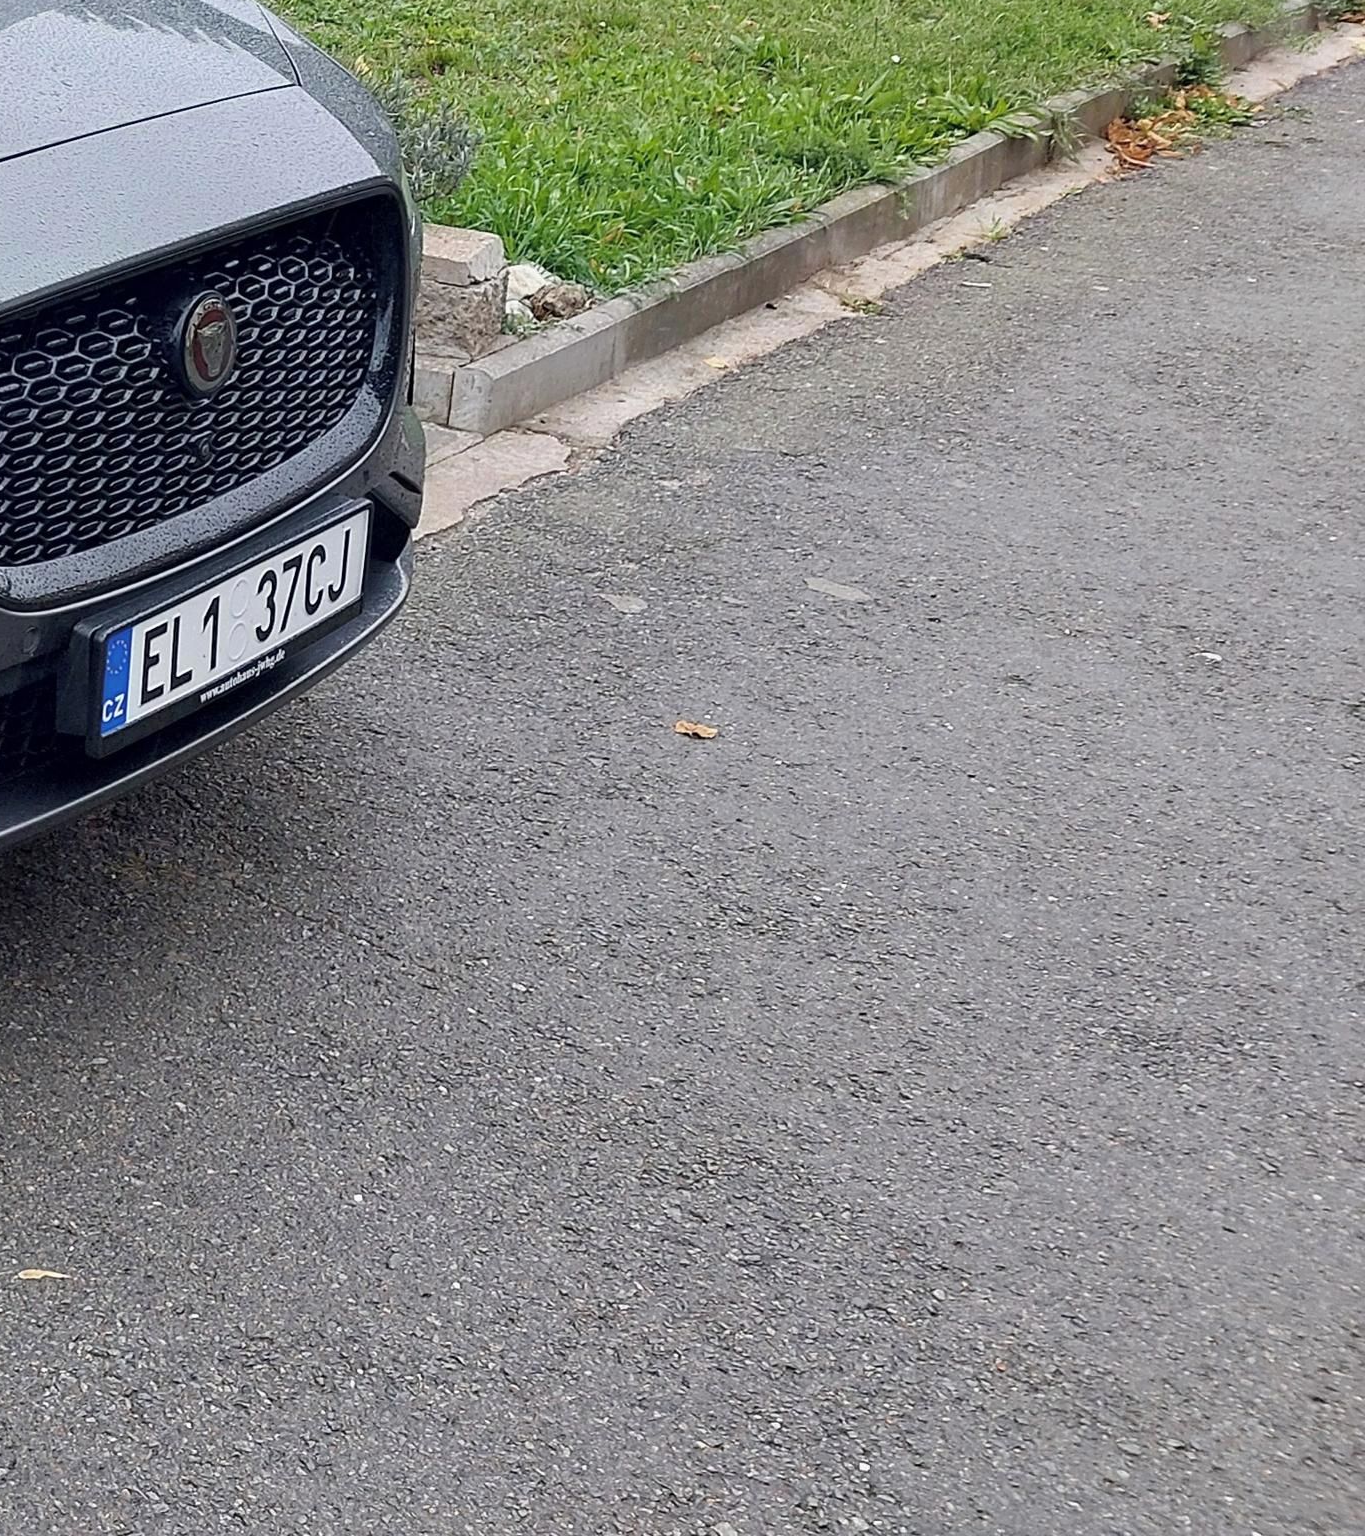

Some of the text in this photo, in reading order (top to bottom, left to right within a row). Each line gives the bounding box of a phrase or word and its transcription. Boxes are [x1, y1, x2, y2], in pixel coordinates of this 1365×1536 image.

[140, 526, 352, 707] EL1 37CJ
[101, 693, 125, 723] CZ
